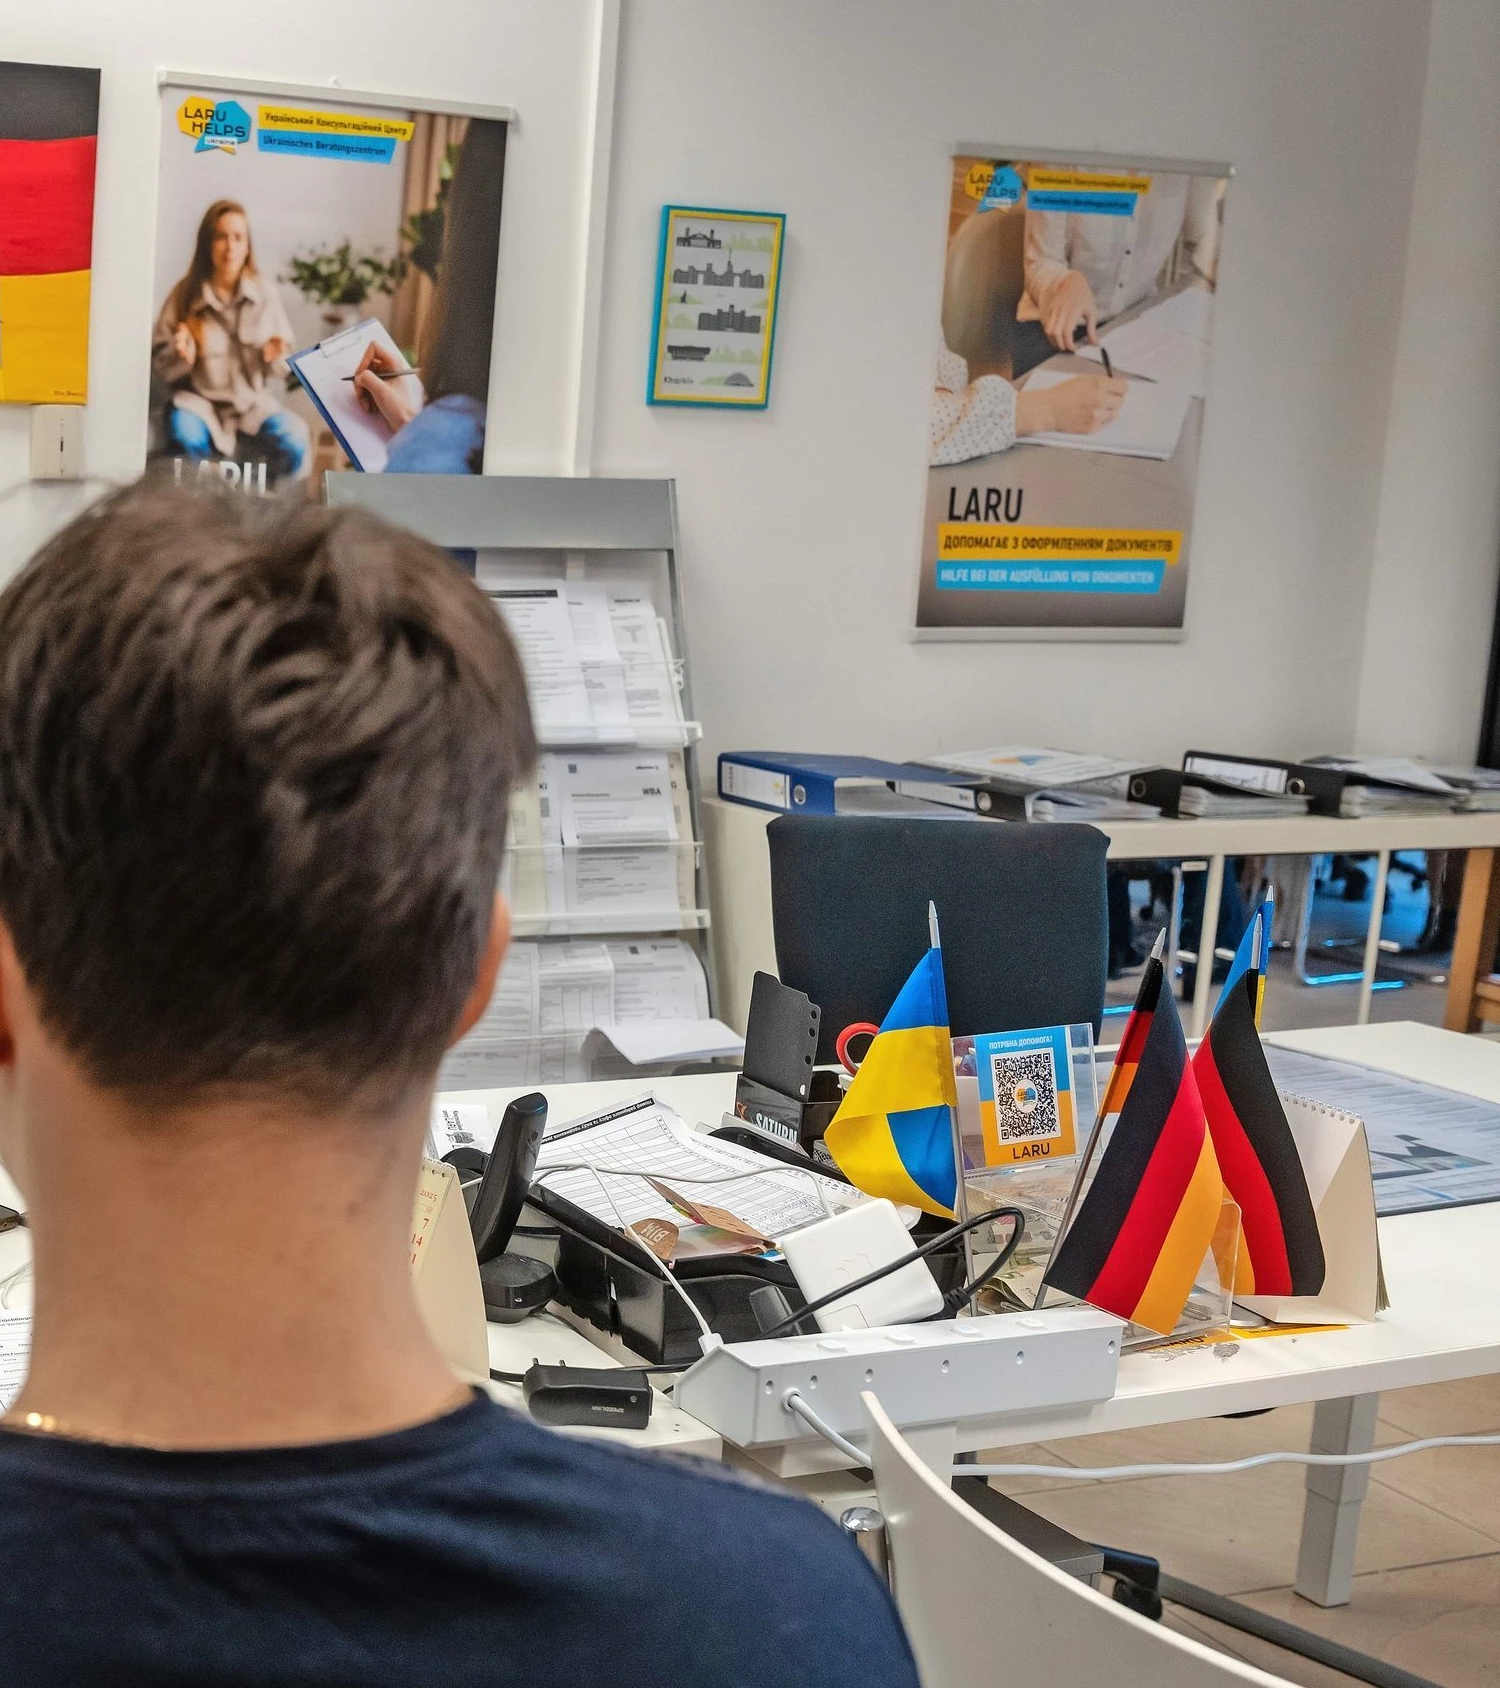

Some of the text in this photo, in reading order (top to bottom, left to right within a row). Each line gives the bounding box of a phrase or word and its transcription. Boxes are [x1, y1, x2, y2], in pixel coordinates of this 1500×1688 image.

[184, 106, 226, 122] LARU
[192, 122, 245, 138] HELPS
[948, 486, 1023, 522] LARU
[943, 535, 1009, 550] ДОПОМАГАЄ
[1105, 538, 1173, 552] ДОКУМЕНТІВ
[989, 1039, 1018, 1050] ПОТРІБНА
[756, 1113, 798, 1143] SATURN
[1012, 1143, 1050, 1159] LARU
[420, 1188, 438, 1202] 2025
[422, 1218, 429, 1229] 7
[411, 1233, 423, 1247] 14
